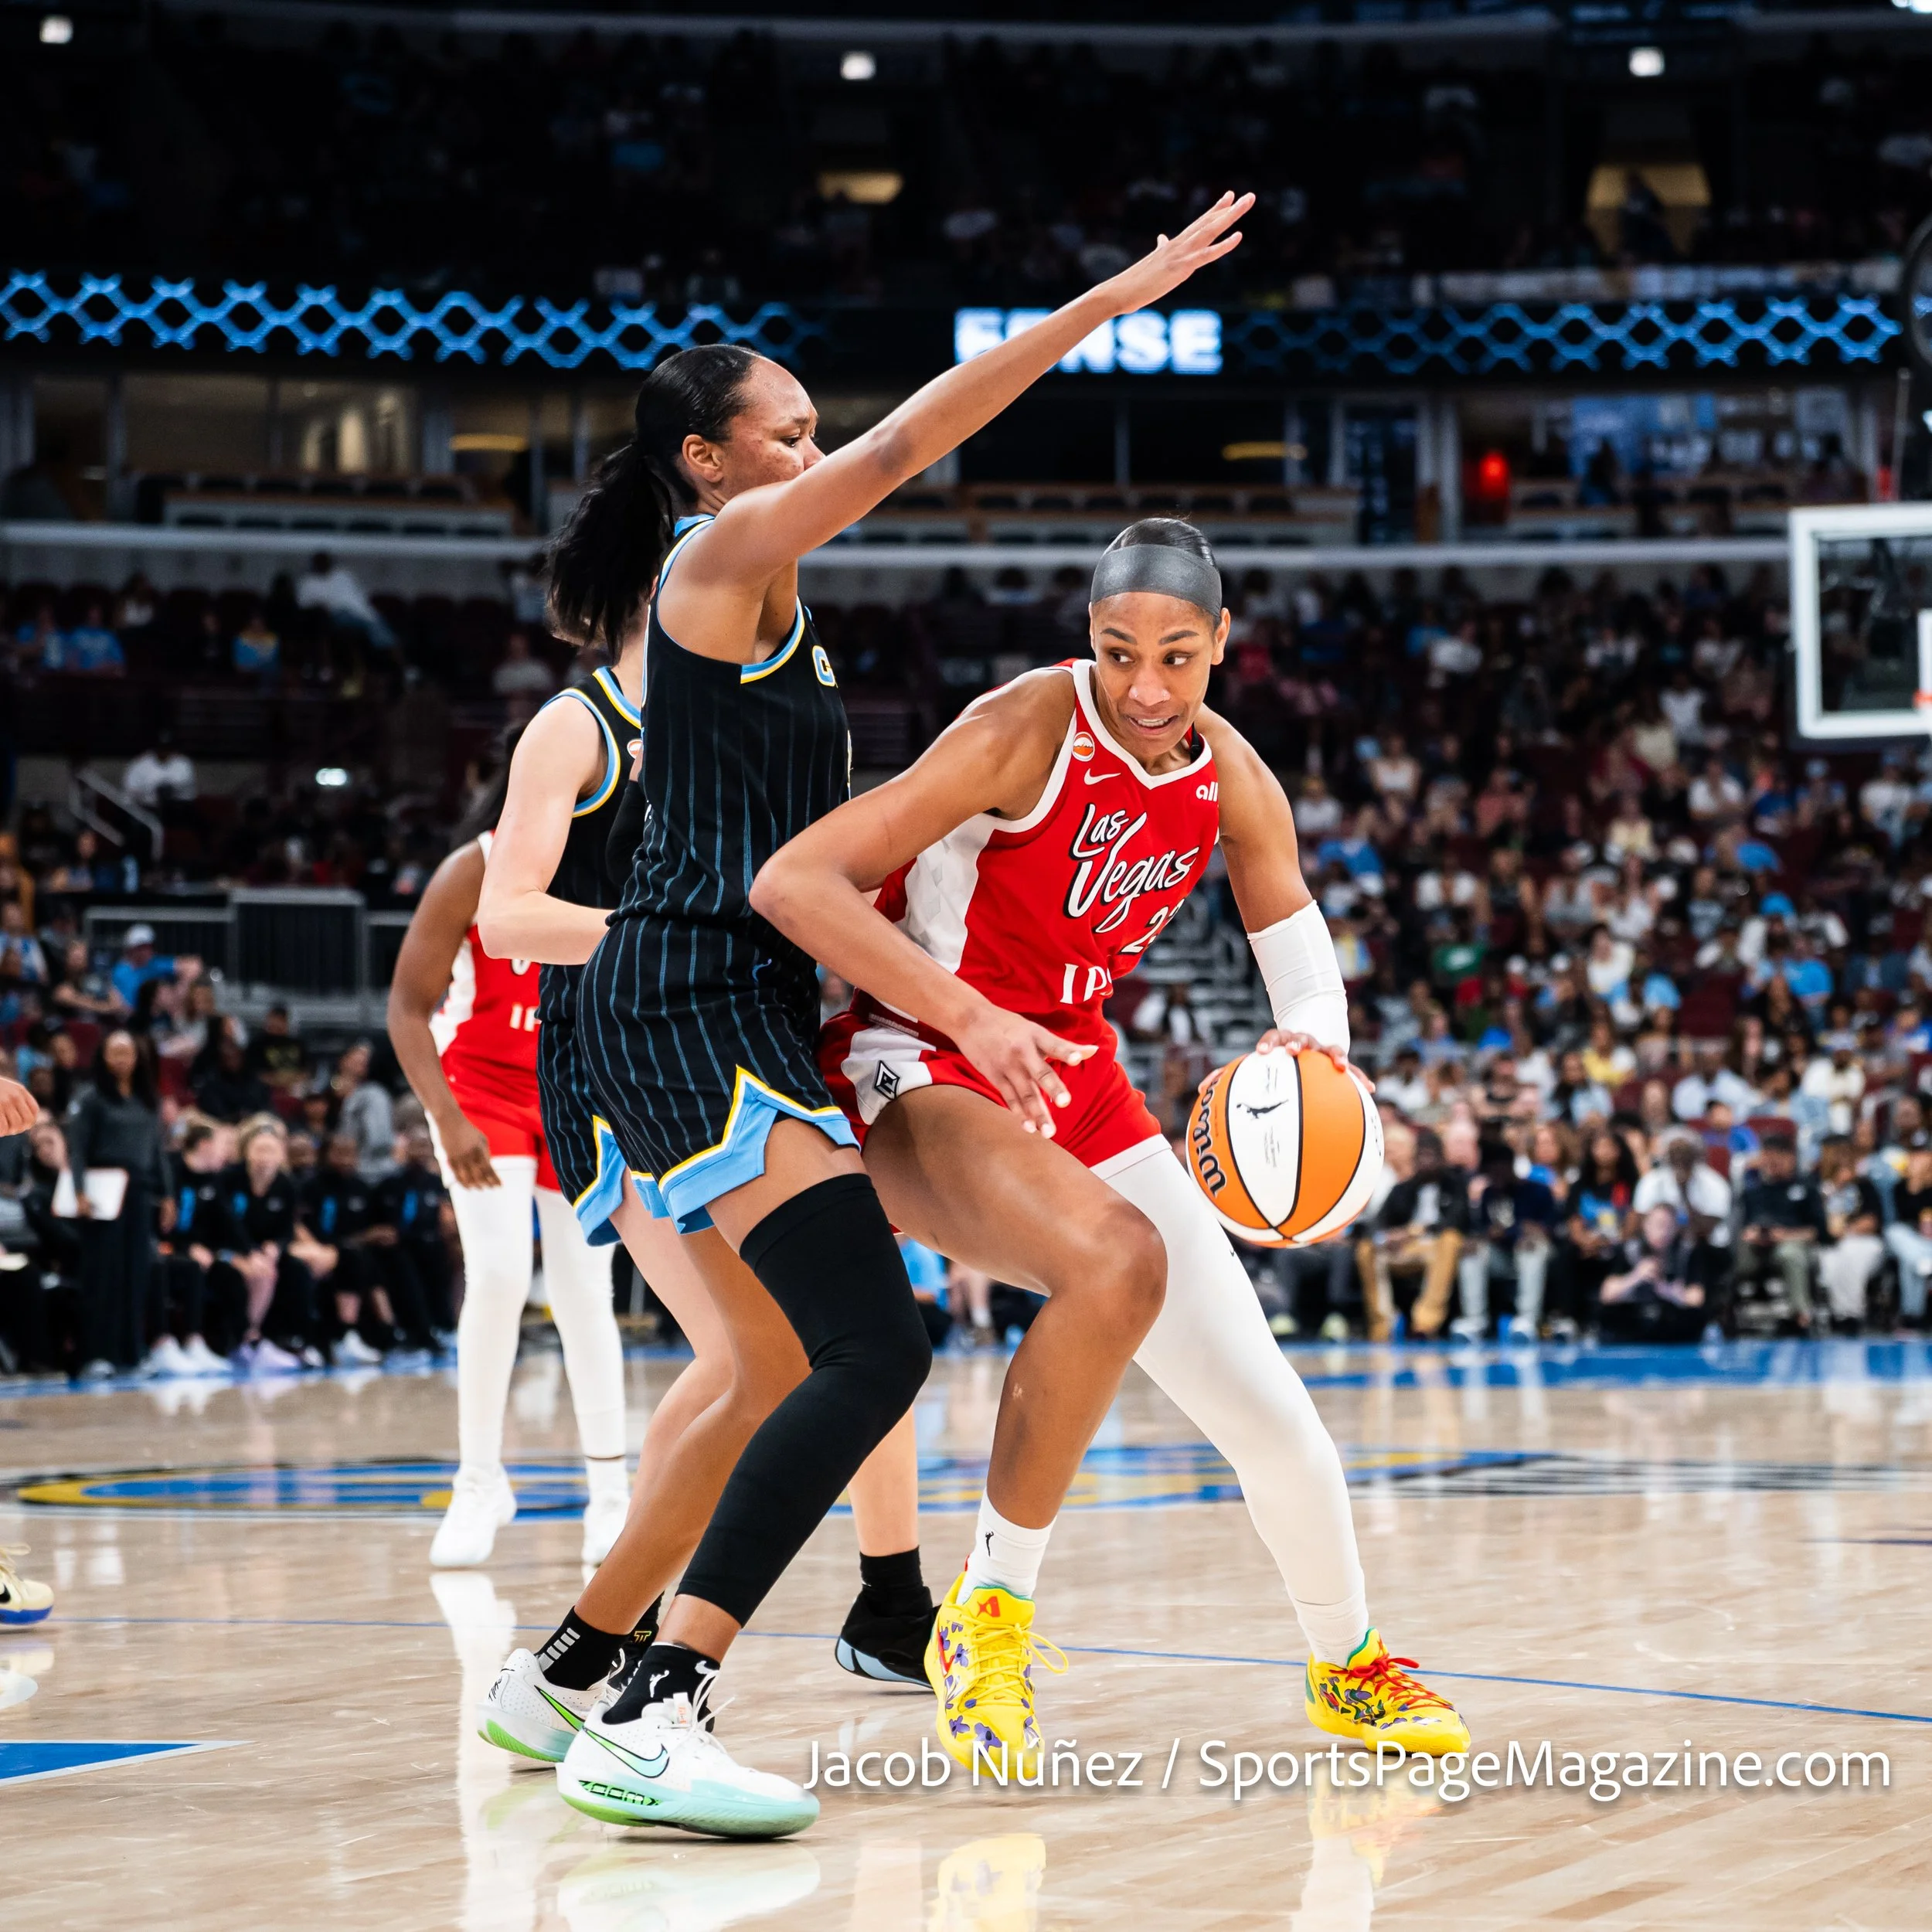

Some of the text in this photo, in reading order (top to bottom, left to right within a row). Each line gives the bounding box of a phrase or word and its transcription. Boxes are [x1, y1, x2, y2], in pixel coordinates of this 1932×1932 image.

[1070, 803, 1129, 860] Las
[1064, 812, 1199, 933] Vegas
[1060, 964, 1113, 1004] IP
